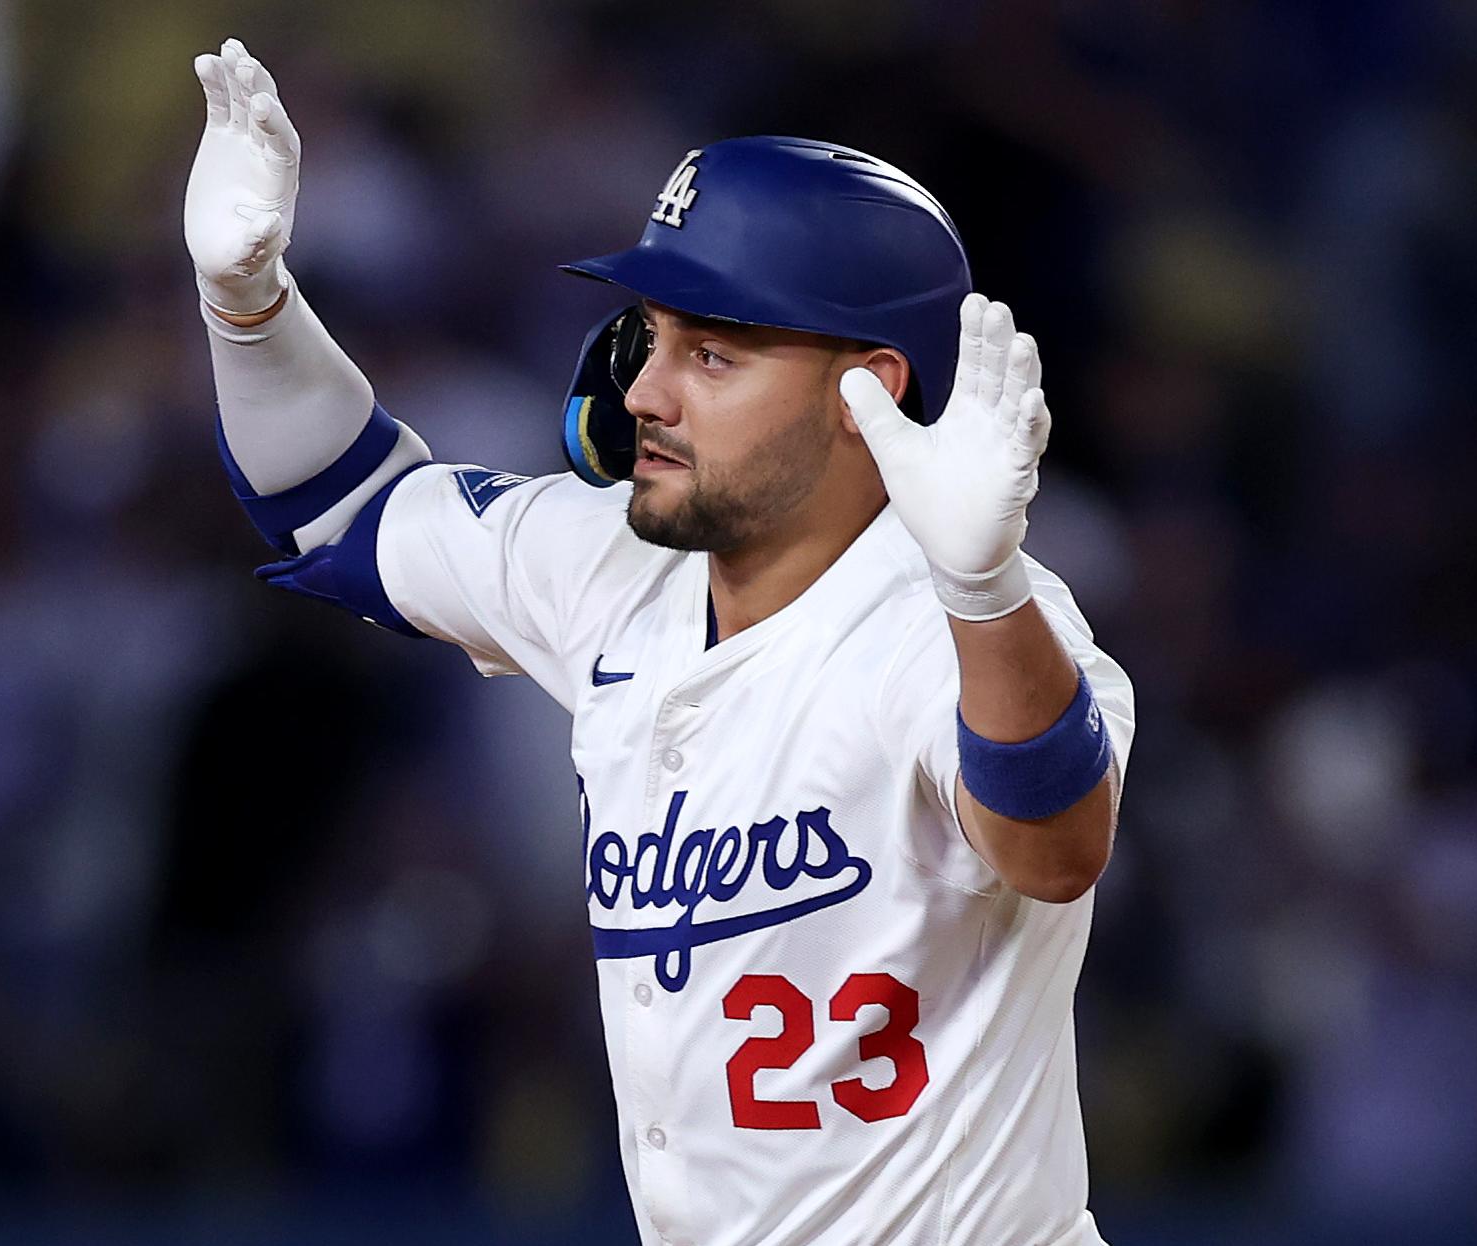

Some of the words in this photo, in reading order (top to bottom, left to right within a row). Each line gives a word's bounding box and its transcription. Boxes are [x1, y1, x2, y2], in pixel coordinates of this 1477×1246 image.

[651, 150, 703, 227] LA
[576, 773, 872, 993] odgers
[721, 973, 930, 1130] 23
